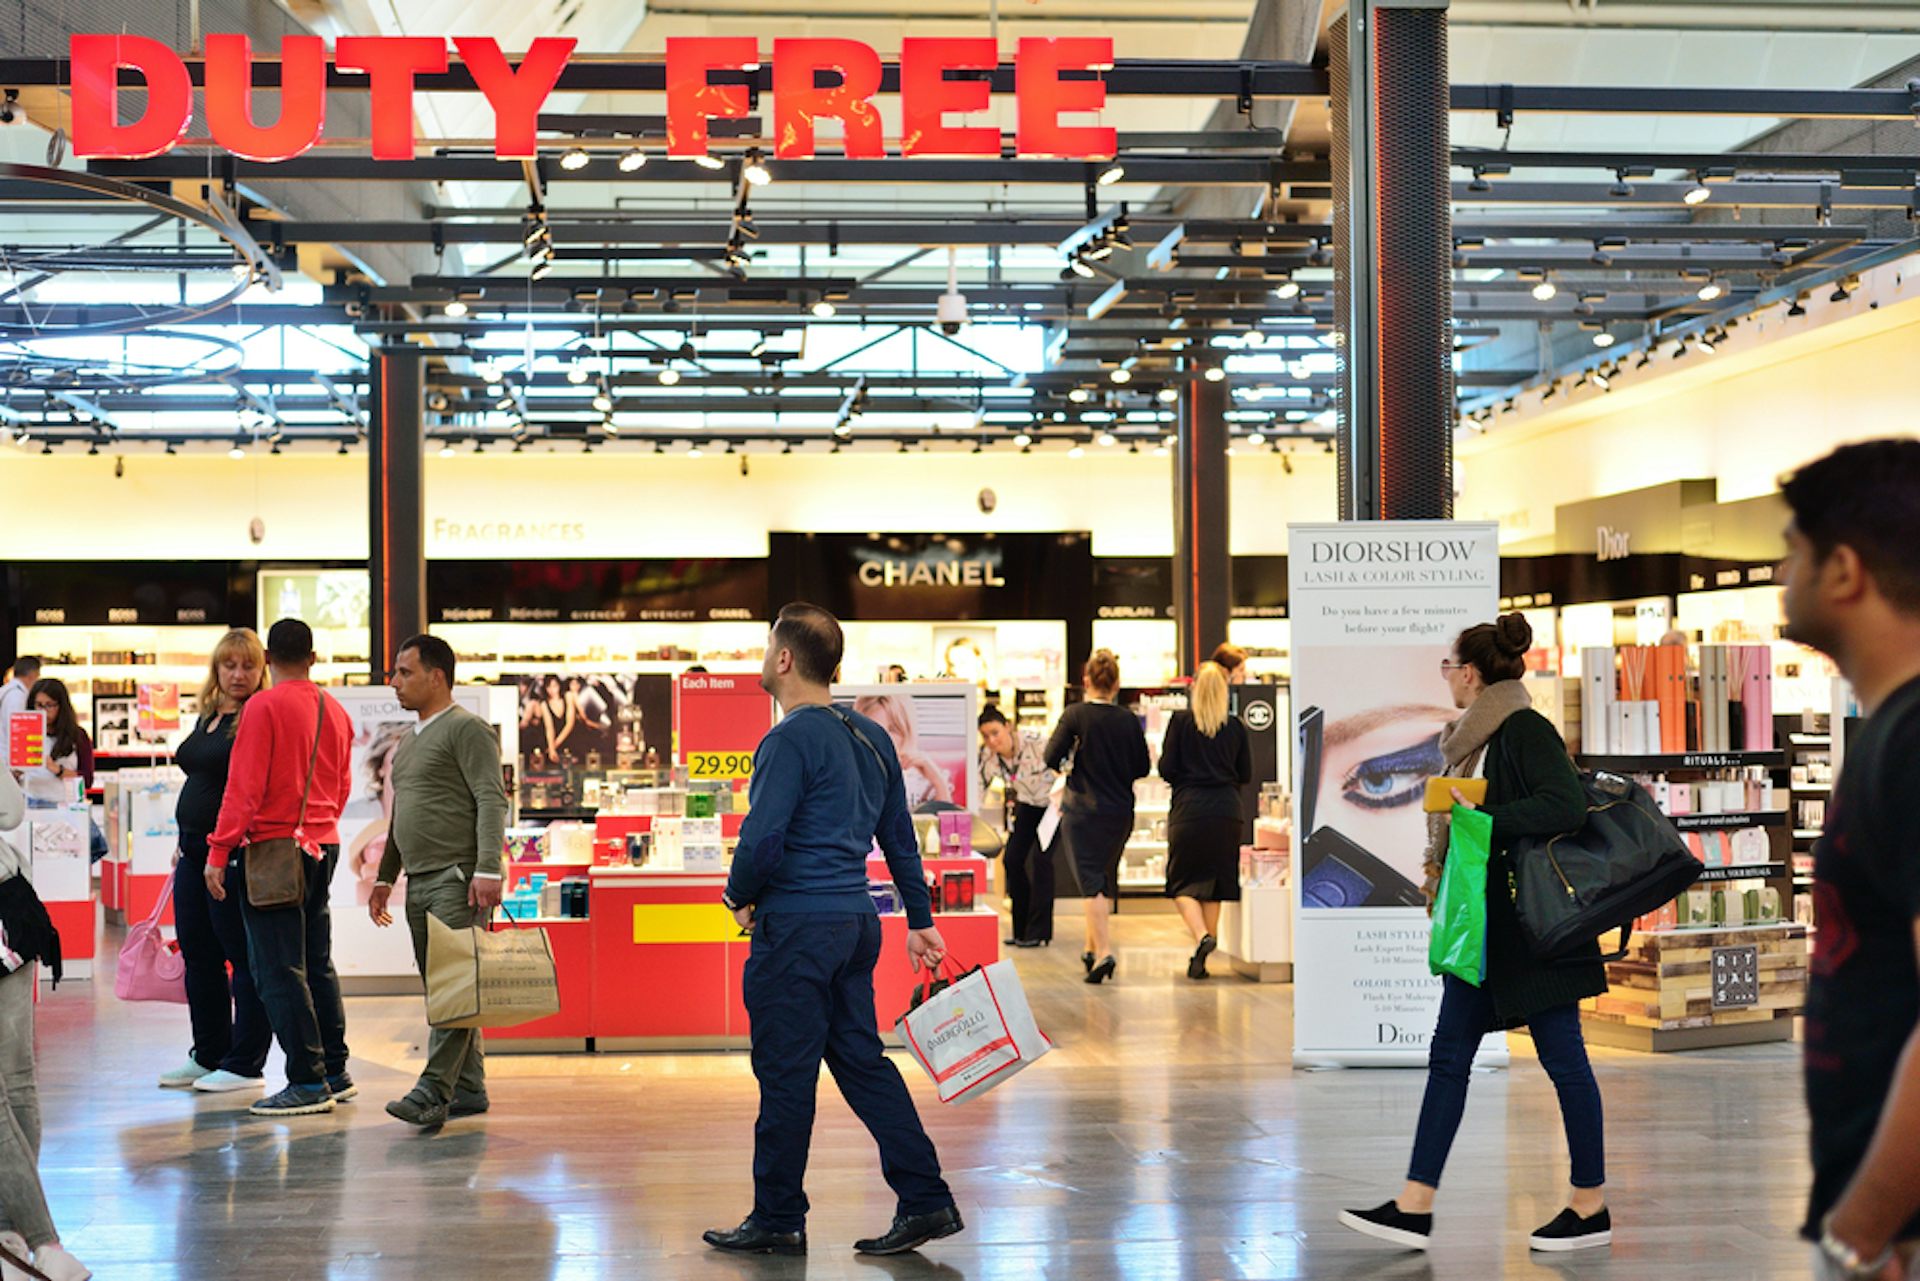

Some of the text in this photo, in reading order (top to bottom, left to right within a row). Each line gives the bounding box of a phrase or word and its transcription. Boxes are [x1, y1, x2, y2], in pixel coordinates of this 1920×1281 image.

[71, 34, 1117, 162] DUTY FREE
[1597, 524, 1630, 562] Dior
[1312, 541, 1476, 564] DIORSHOW
[860, 560, 1005, 587] CHANEL
[1304, 568, 1485, 583] LASH & COLOR STYLING
[709, 608, 752, 619] CHANEL
[1098, 605, 1155, 618] GUERLAIN
[1322, 603, 1468, 620] Do you have a few minutes
[1345, 622, 1445, 637] before your flight?
[682, 677, 735, 689] Each Item
[694, 755, 752, 775] 29.90
[1357, 930, 1431, 940] LASH STYLIN
[1354, 944, 1373, 952] Lash
[1353, 979, 1391, 988] COLOR
[1363, 993, 1384, 1001] Flash
[1377, 1022, 1425, 1044] Dior
